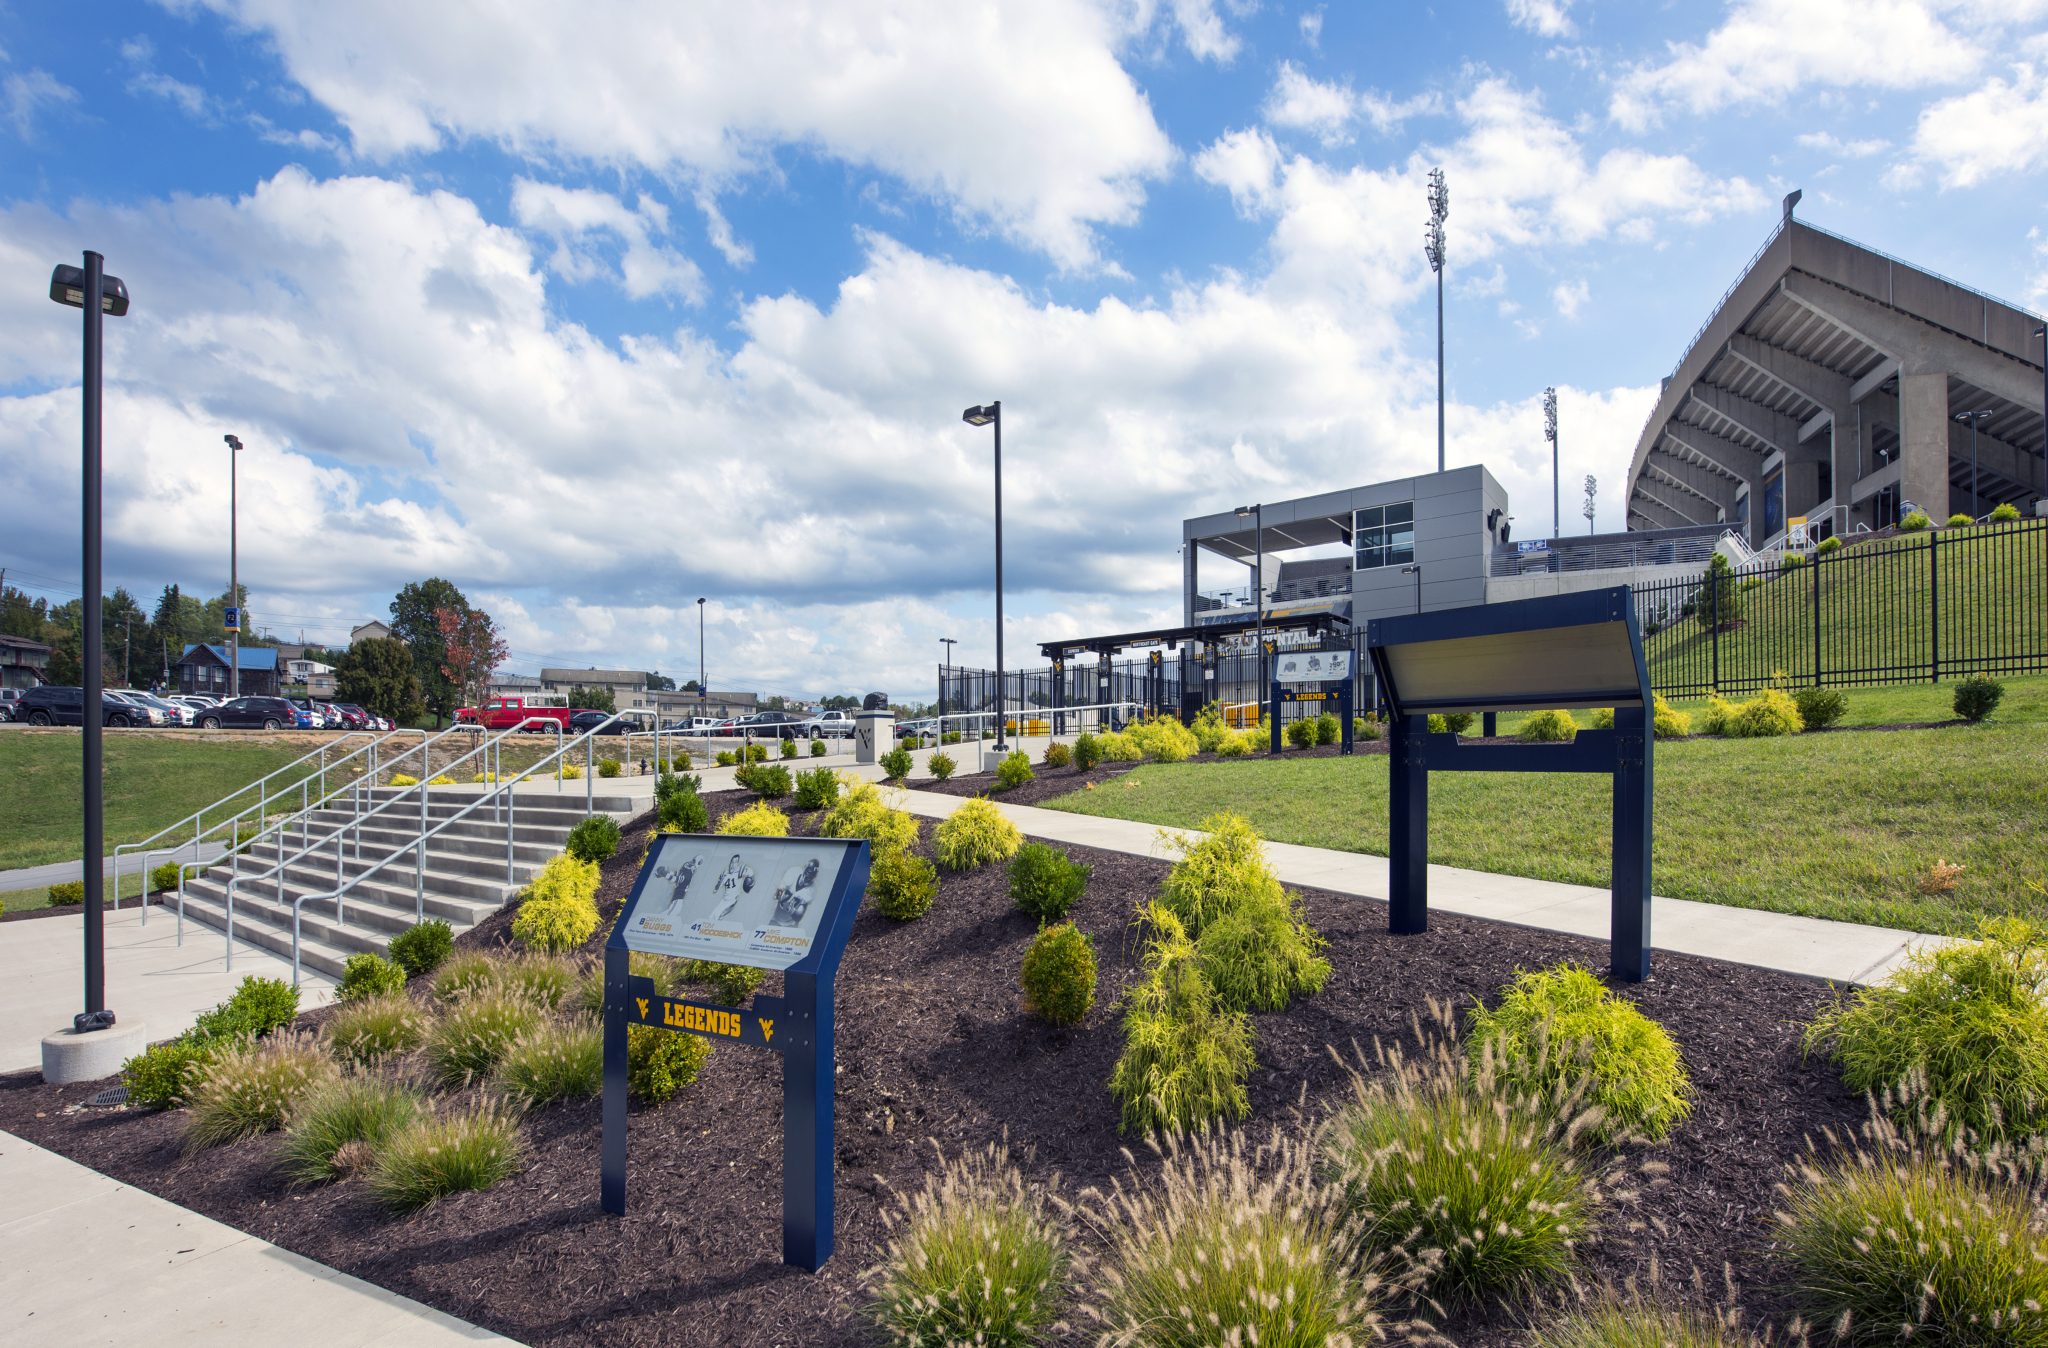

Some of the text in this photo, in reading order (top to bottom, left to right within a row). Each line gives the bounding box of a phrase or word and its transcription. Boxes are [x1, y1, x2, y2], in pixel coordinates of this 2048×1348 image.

[1296, 692, 1327, 701] LEGENDS
[724, 878, 736, 889] 41
[639, 917, 646, 925] 8
[691, 921, 715, 931] 41 TOM
[642, 922, 672, 932] BUGGS
[754, 928, 781, 939] 77 MIKE
[763, 935, 810, 948] COMPTON
[663, 1001, 741, 1038] LEGENDS
